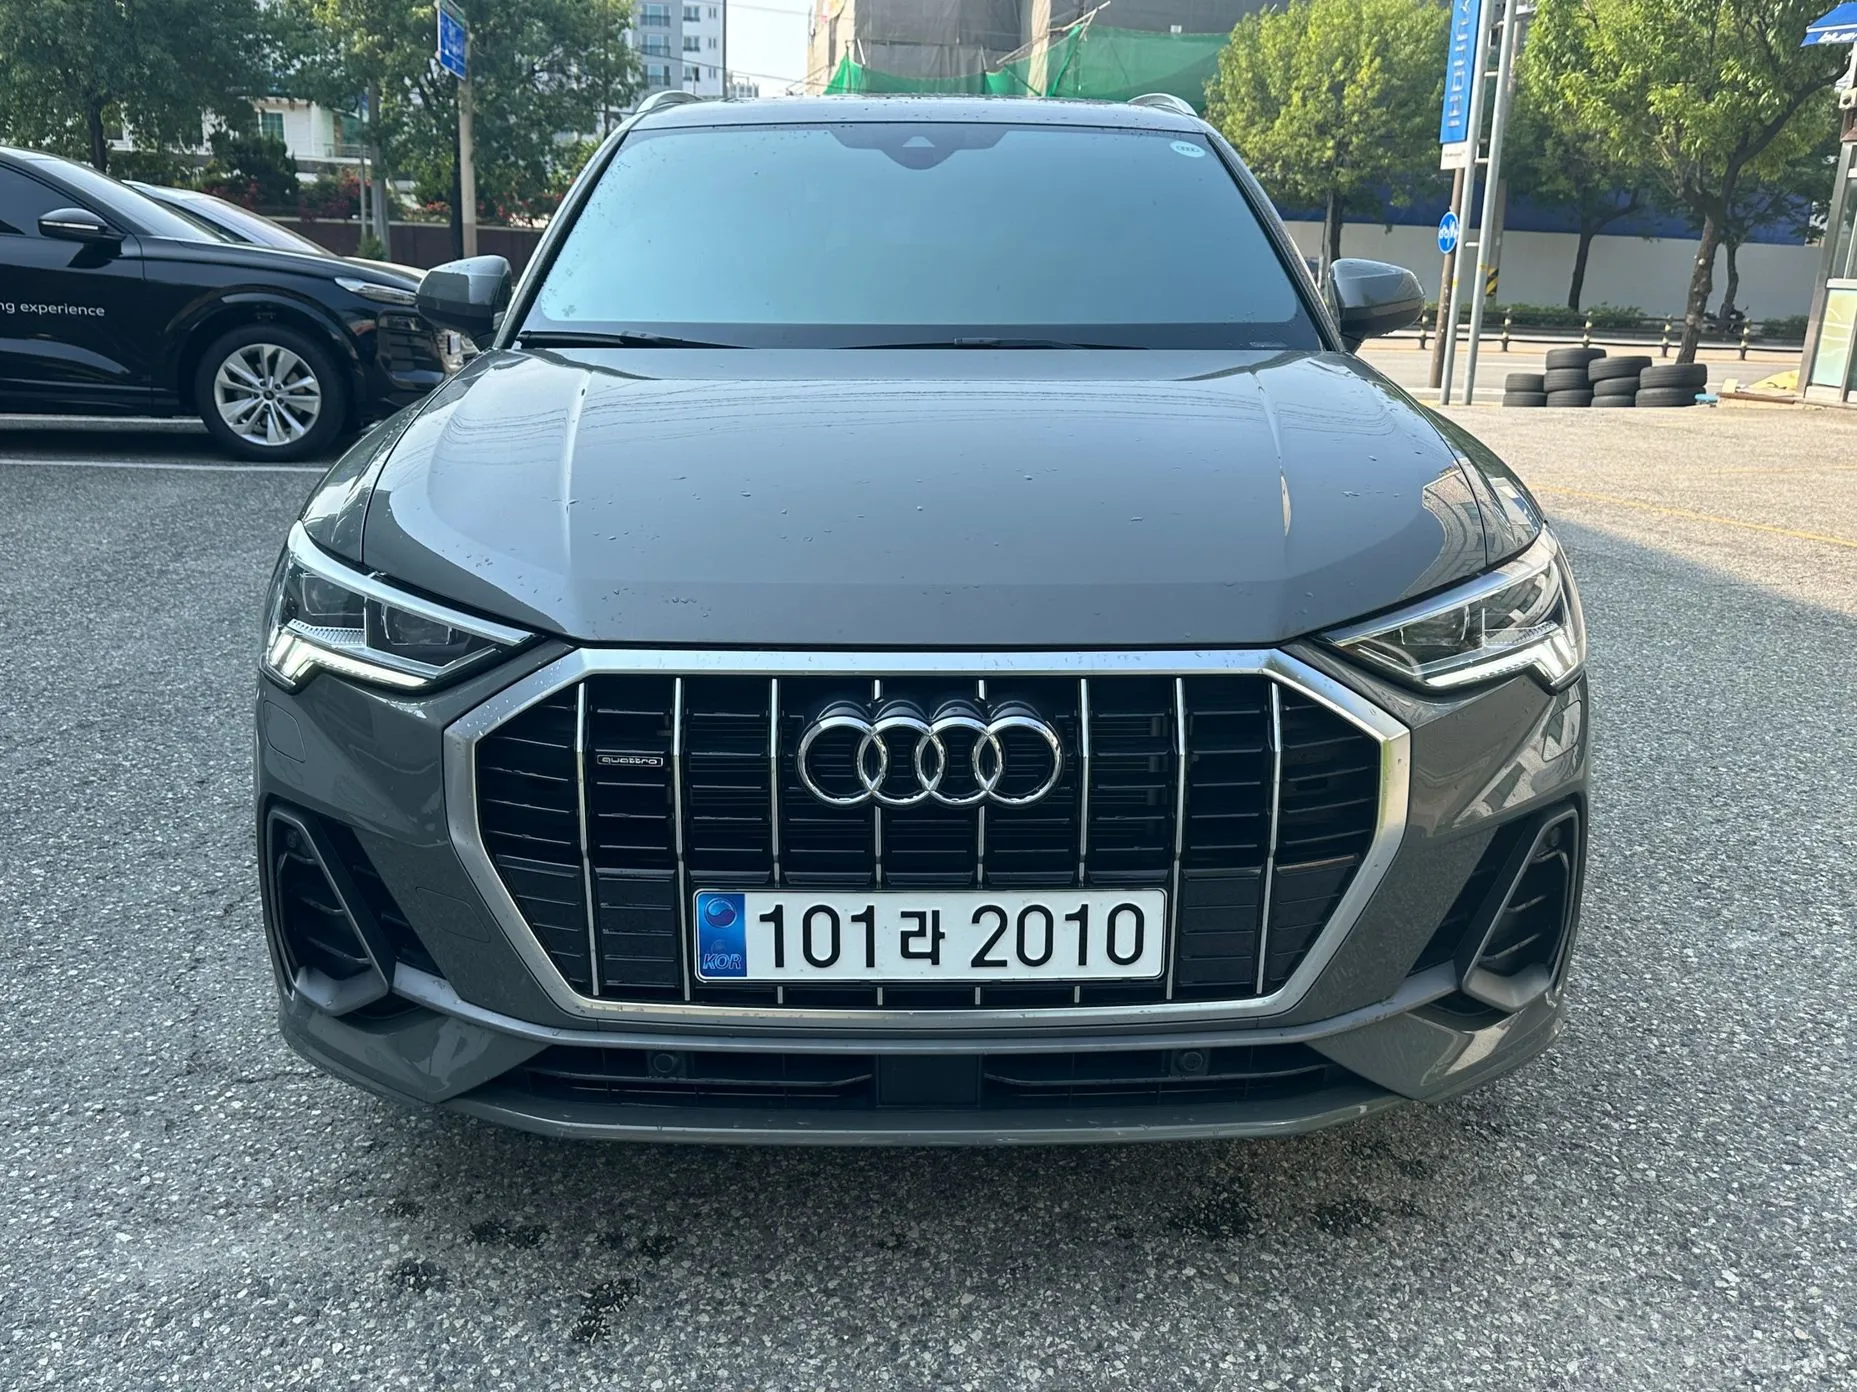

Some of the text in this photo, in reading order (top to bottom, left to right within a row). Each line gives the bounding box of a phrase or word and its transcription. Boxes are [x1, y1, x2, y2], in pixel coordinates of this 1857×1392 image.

[20, 303, 105, 316] experience
[602, 757, 658, 765] quattro
[971, 903, 1145, 967] 2010
[702, 953, 742, 970] KOR
